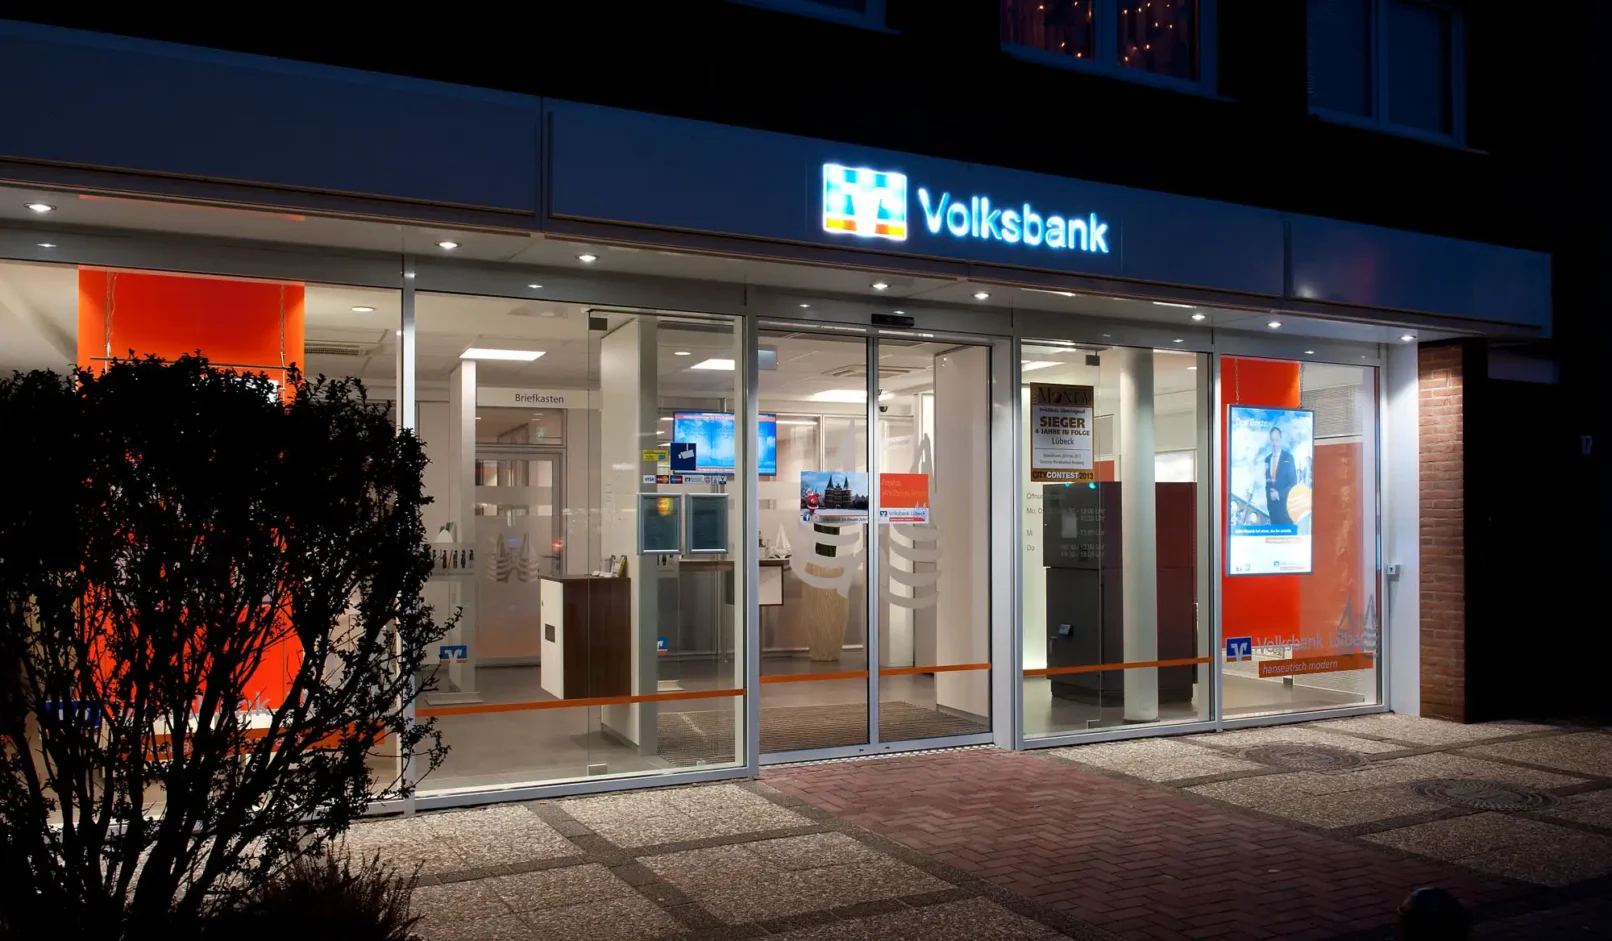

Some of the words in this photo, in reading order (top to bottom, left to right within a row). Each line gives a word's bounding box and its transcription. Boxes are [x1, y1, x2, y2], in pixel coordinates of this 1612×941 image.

[917, 187, 1109, 253] Volksbank
[515, 393, 564, 403] Briefkasten
[1039, 416, 1086, 428] SIEGER
[1052, 437, 1074, 445] Lübeck
[1257, 632, 1325, 654] Volksbank
[1262, 664, 1307, 674] hanseatisch
[1308, 660, 1338, 669] modern
